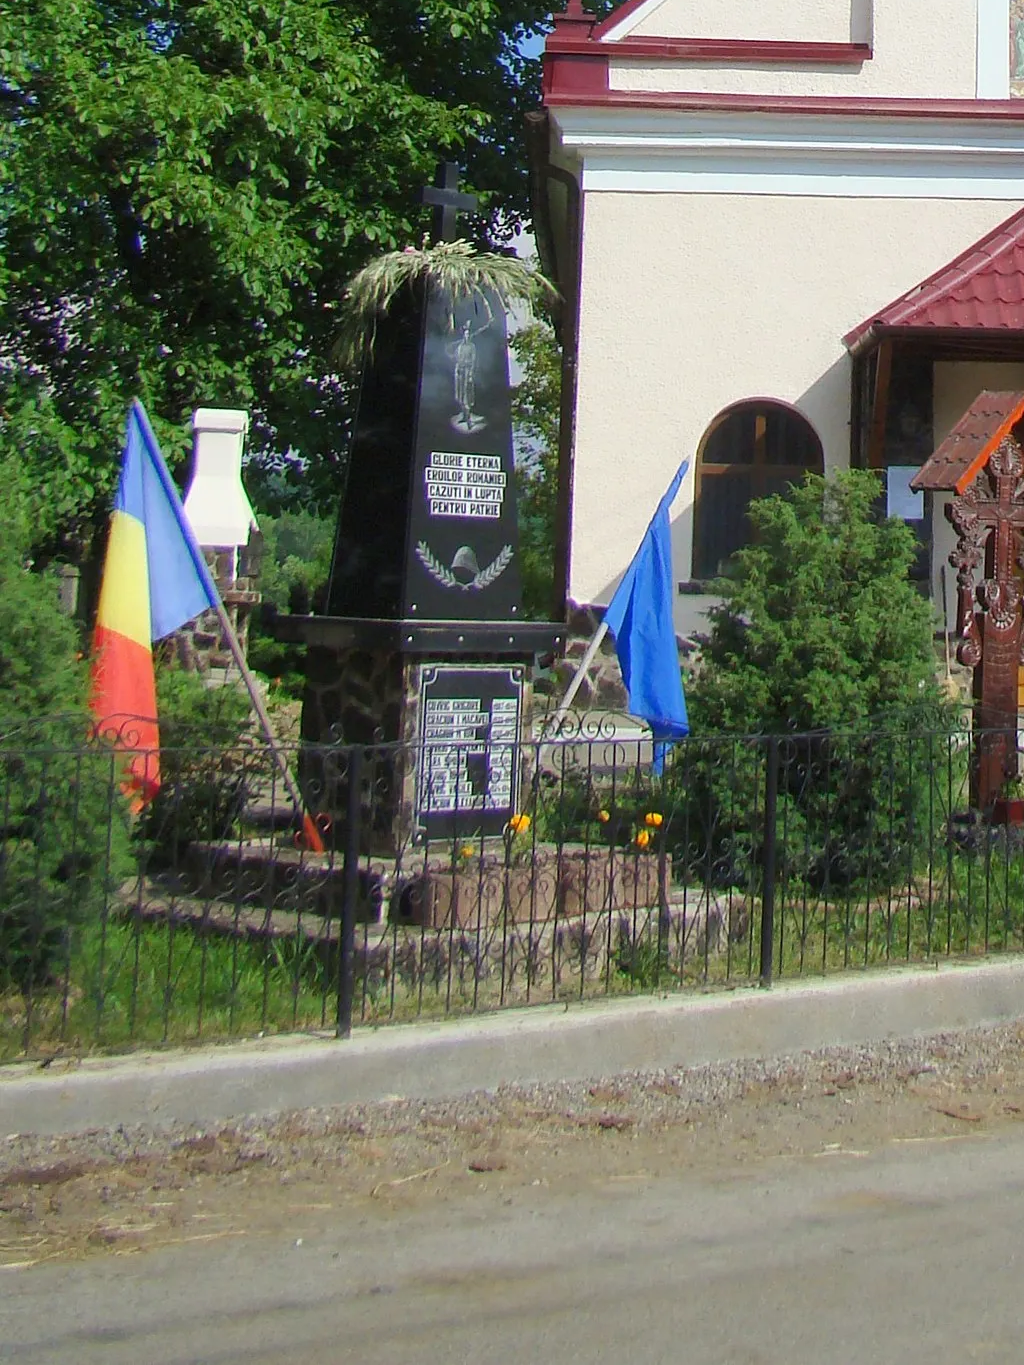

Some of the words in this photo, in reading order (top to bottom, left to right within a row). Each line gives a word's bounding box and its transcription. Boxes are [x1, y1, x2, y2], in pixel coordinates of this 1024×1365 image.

[466, 456, 499, 469] ETERNA
[427, 469, 463, 482] EROILOR
[466, 472, 504, 484] ROMANIEI
[429, 485, 462, 498] CAZUTI
[464, 487, 472, 498] IN
[475, 488, 502, 500] LUPTA
[432, 501, 466, 514] PENTRU
[470, 503, 499, 516] PATRIE
